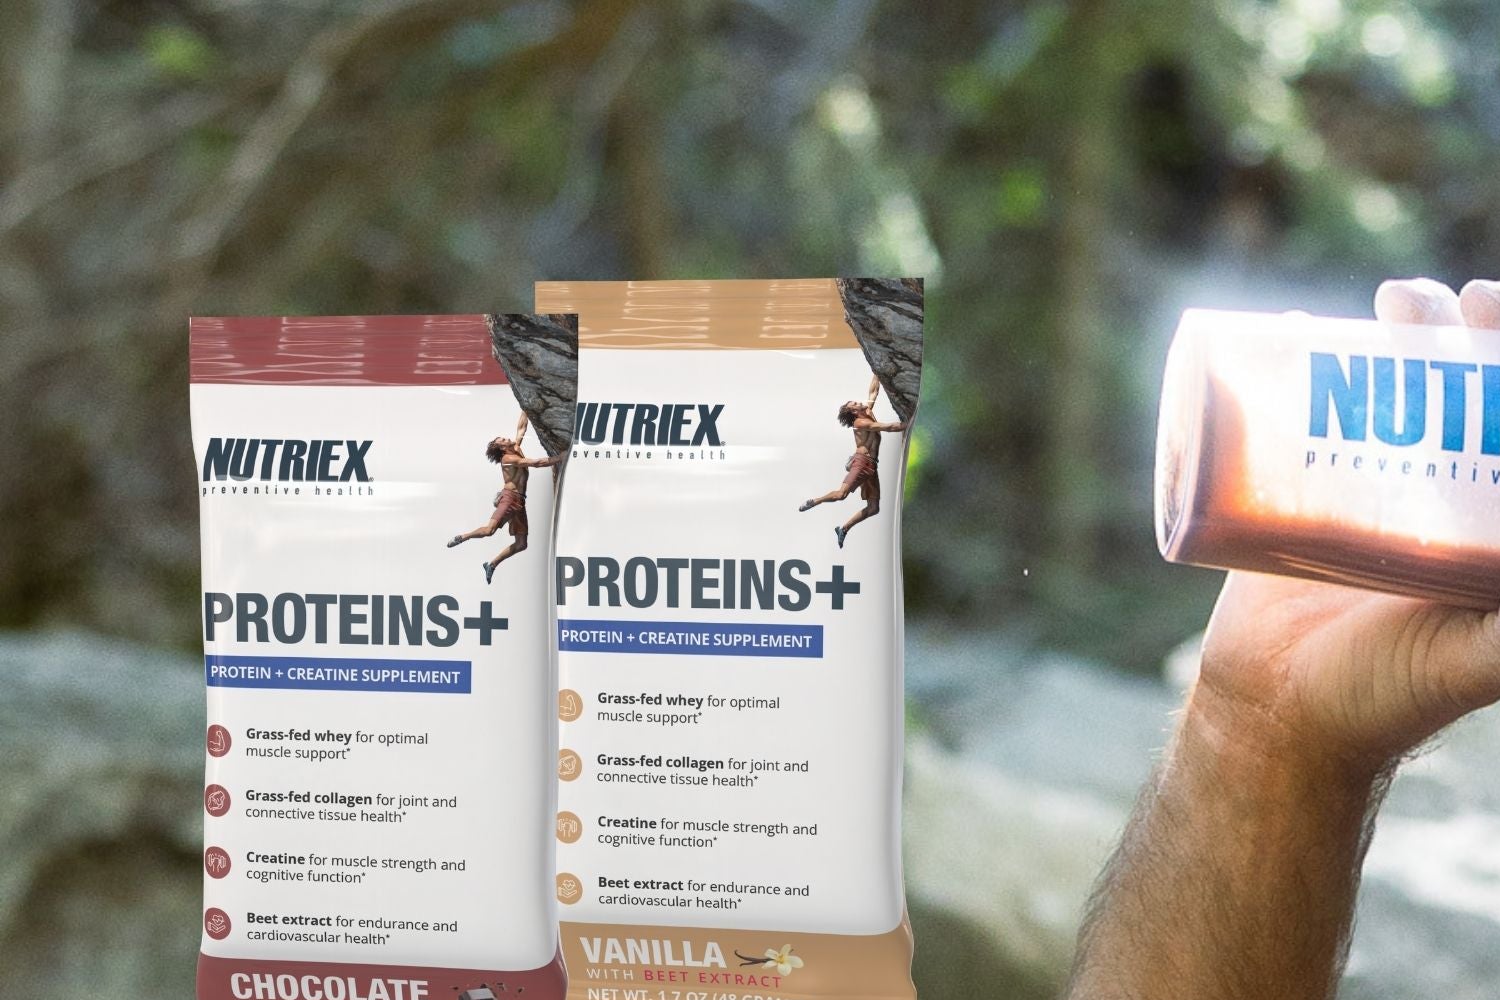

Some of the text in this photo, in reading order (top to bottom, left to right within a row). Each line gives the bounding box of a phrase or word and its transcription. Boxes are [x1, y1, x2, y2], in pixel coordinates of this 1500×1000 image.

[573, 449, 725, 460] eventive health
[203, 485, 373, 497] preventive health
[556, 557, 860, 611] PROTEINS+
[203, 592, 508, 649] PROTEINS+
[562, 630, 812, 647] PROTEIN + CREATINE SUPPLEMENT
[211, 666, 460, 683] PROTEIN + CREATINE SUPPLEMENT
[598, 693, 779, 711] Grass-fed whey for optimal
[598, 710, 642, 722] muscle
[247, 728, 427, 746] Grass-fed whey for optimal
[247, 746, 291, 757] muscle
[597, 754, 808, 774] Grass-fed collagen for joint and
[597, 773, 666, 784] connective
[670, 773, 708, 785] tissue
[246, 790, 456, 809] Grass-fed collagen for joint and
[246, 808, 314, 819] connective
[319, 809, 356, 821] tissue
[598, 816, 817, 837] Creatine for muscle strength and
[598, 834, 655, 847] cognitive
[247, 852, 465, 872] Creatine for muscle strength and
[247, 870, 303, 883] cognitive
[599, 877, 809, 896] Beet extract for endurance and
[599, 894, 692, 907] cardiovascular
[247, 913, 457, 932] Beet extract for endurance and
[247, 930, 341, 942] cardiovascular
[580, 937, 727, 969] VANILLA
[587, 968, 781, 988] WITH BEET EXTRACT
[588, 988, 618, 1000] NET
